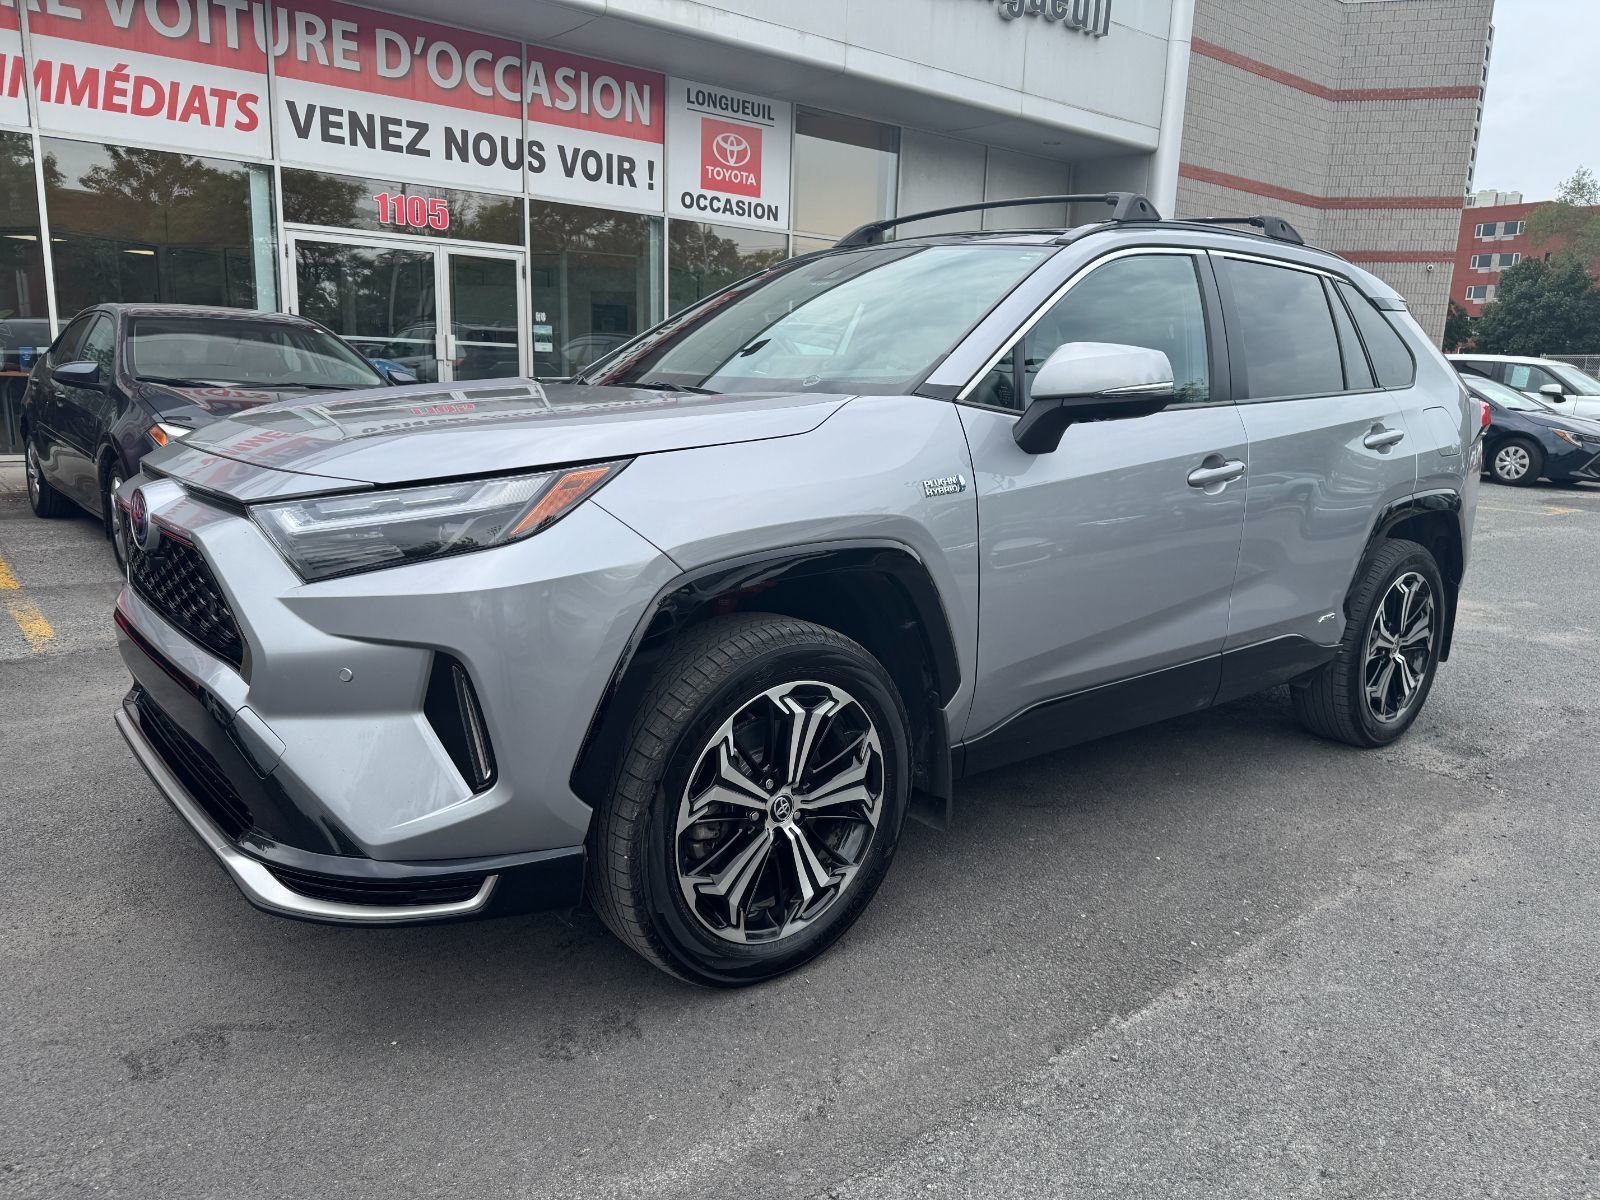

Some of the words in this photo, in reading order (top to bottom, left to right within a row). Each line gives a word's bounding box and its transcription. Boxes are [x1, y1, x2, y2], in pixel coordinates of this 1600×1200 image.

[104, 0, 361, 72] VOITURE
[686, 87, 775, 121] LONGUEUIL
[285, 99, 431, 158] VENEZ
[445, 126, 546, 174] NOUS
[557, 144, 638, 188] VOIR
[706, 165, 757, 186] TOYOTA
[374, 192, 449, 230] 1105
[681, 191, 779, 222] OCCASION
[923, 474, 959, 488] PLUG-IN
[925, 484, 960, 498] HYBRID
